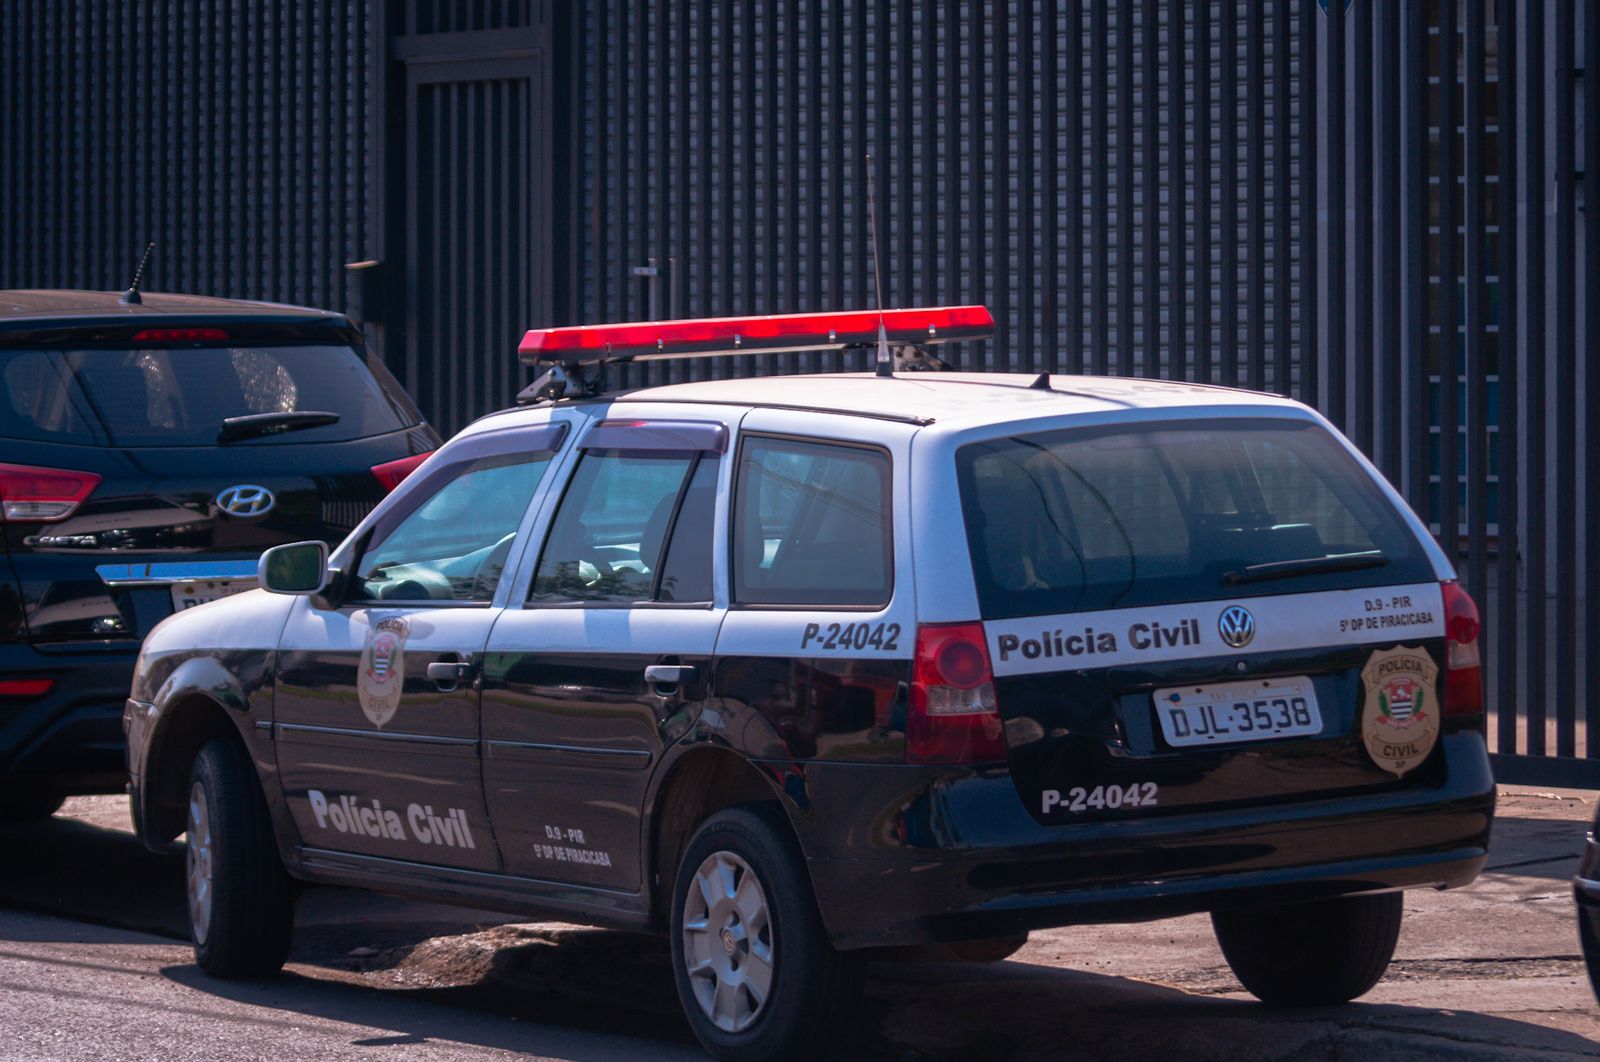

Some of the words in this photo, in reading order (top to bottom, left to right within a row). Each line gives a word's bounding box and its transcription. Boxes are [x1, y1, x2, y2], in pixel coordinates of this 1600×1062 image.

[1364, 599, 1383, 612] D.9
[1392, 596, 1412, 608] PIR
[1351, 618, 1363, 631] DP
[1366, 616, 1379, 629] DE
[1380, 612, 1433, 628] PIRACICABA
[801, 622, 901, 650] P-24042
[998, 628, 1117, 661] Polícia
[1128, 618, 1200, 650] Civil
[1383, 744, 1419, 757] CIVIL
[1042, 782, 1158, 814] P-24042
[308, 789, 408, 841] Polícia
[407, 803, 475, 849] Civil
[567, 828, 585, 844] PIR
[542, 845, 553, 859] DP
[553, 846, 567, 861] DE
[565, 848, 612, 867] PIRACICABA
